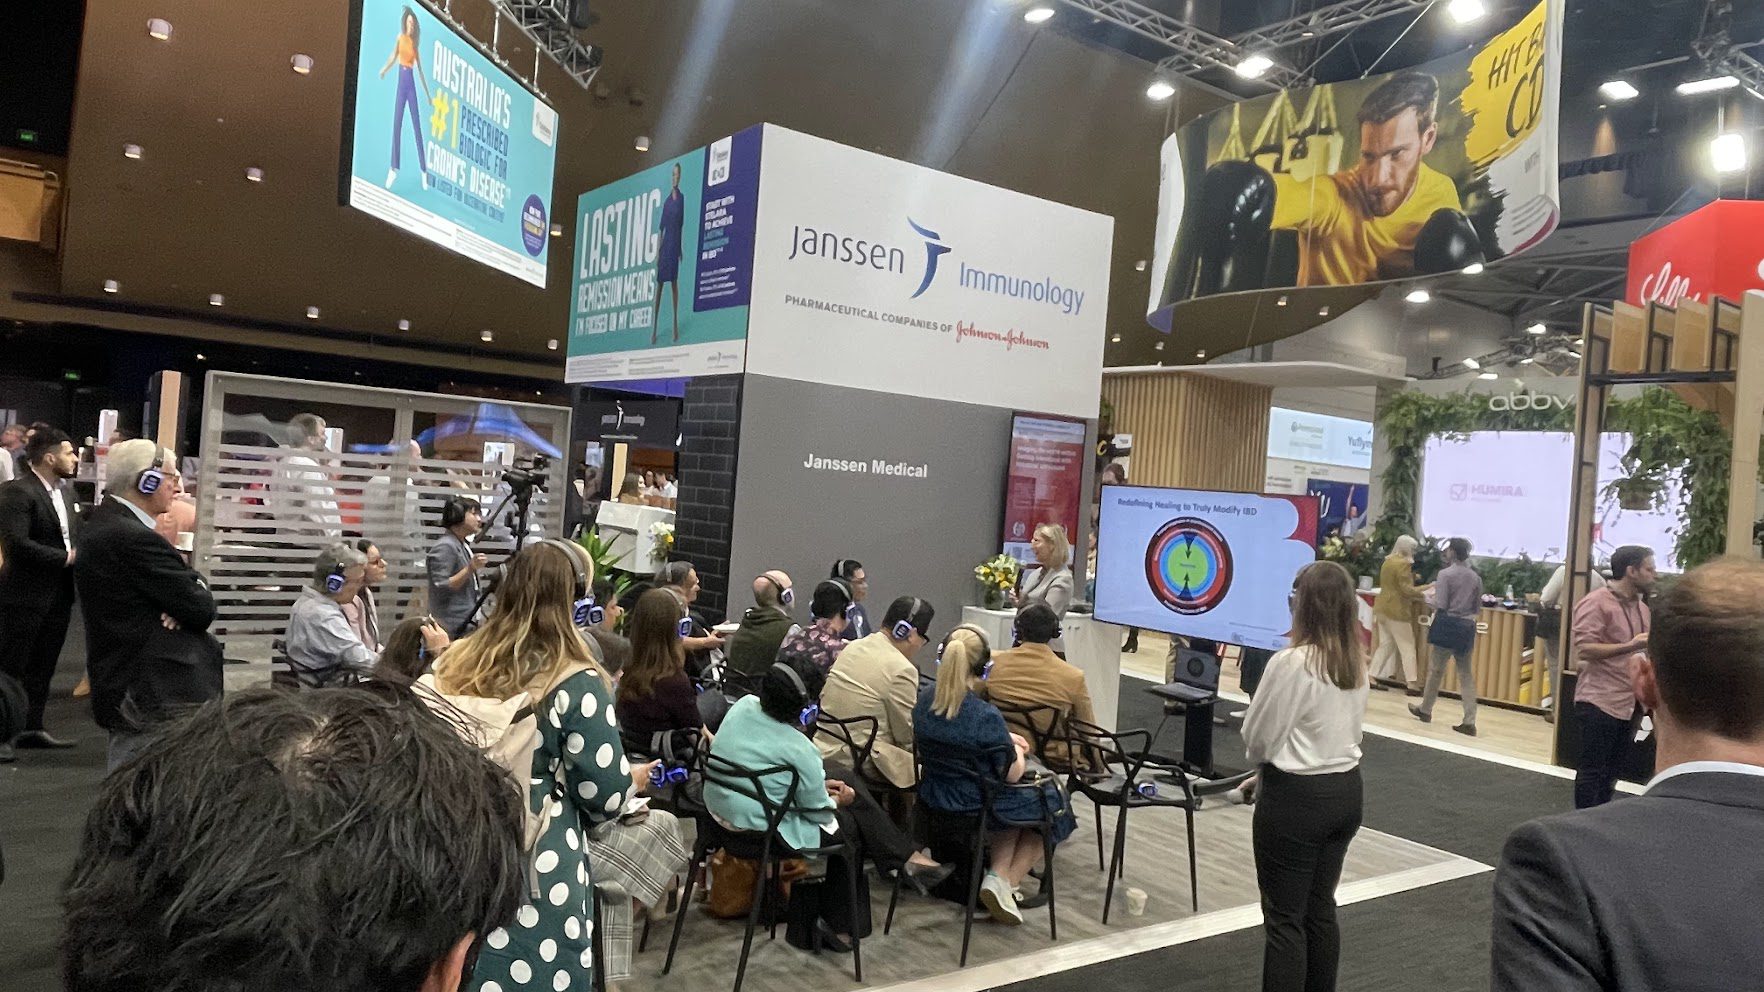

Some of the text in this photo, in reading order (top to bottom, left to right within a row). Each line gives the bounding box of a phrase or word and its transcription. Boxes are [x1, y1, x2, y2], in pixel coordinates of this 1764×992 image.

[432, 40, 511, 130] AUSTRALIA'S
[1488, 36, 1527, 90] HIT
[430, 87, 459, 149] #1
[460, 105, 509, 157] PRESCRIBED
[427, 140, 466, 188] CROHN'S
[470, 166, 506, 209] DISEASE
[459, 135, 507, 180] BIOLOGIC FOR
[580, 188, 661, 279] LASTING
[577, 278, 623, 313] REMISSION
[622, 268, 656, 306] MEANS
[788, 224, 1085, 315] Janssen Immunology
[1641, 261, 1700, 308] Lill
[784, 294, 880, 321] PHARMACEUTICAL
[881, 312, 938, 332] COMPANIES
[940, 322, 953, 333] OF
[803, 453, 928, 478] Janssen Medical
[1117, 498, 1258, 516] Redefining Healing to Truly Modify IBD
[1470, 484, 1524, 498] HUMIRA
